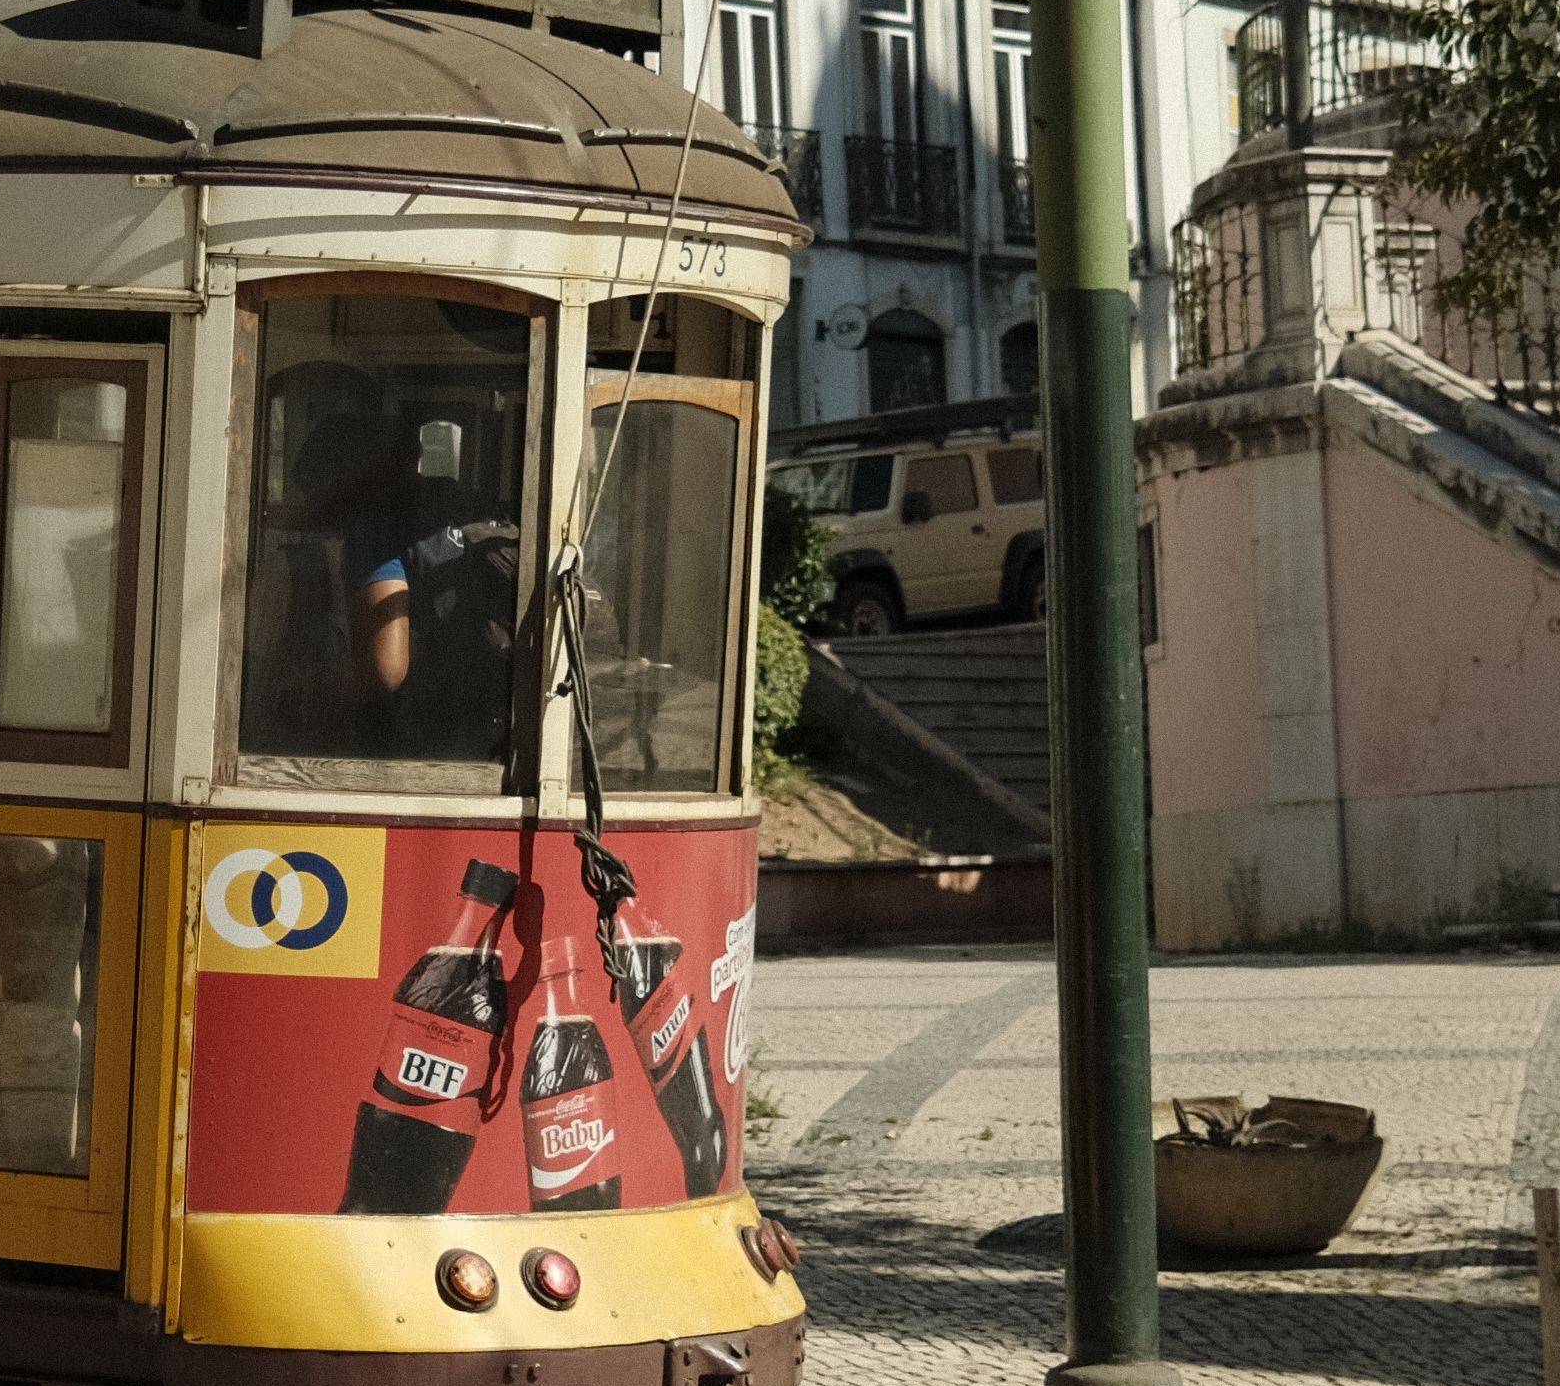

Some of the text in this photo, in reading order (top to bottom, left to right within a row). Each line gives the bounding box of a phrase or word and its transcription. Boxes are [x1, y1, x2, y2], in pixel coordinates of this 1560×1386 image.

[677, 234, 728, 278] 573
[652, 999, 689, 1060] Amor
[402, 1051, 465, 1094] BFF
[545, 1121, 601, 1156] Baby
